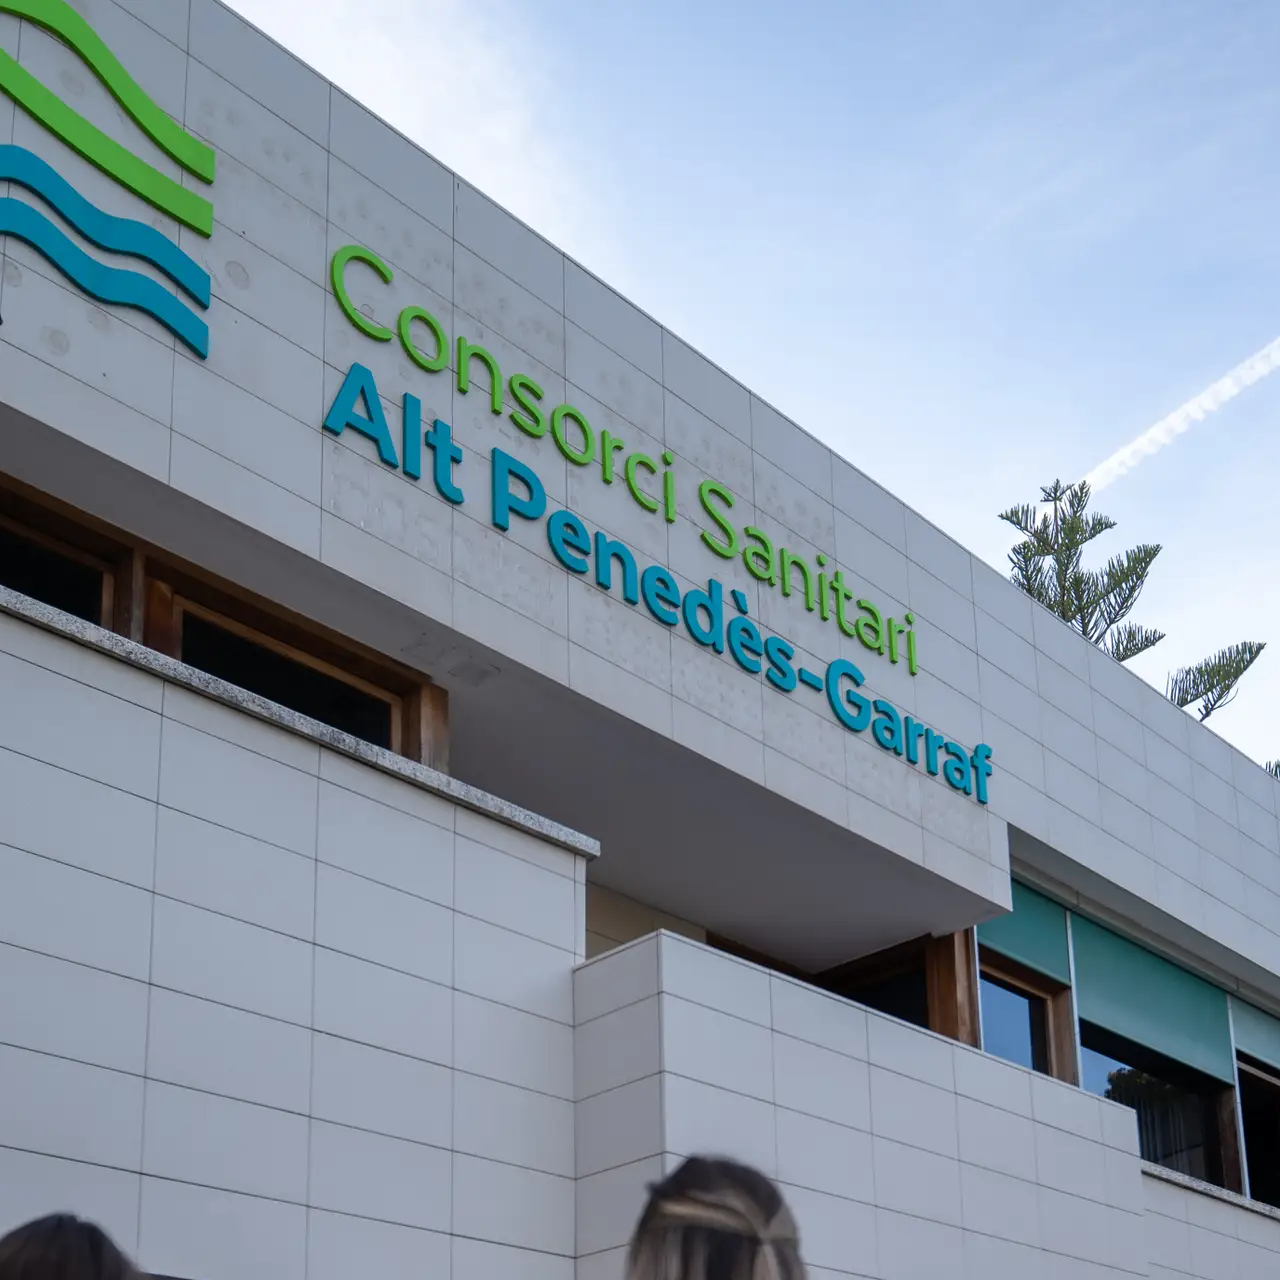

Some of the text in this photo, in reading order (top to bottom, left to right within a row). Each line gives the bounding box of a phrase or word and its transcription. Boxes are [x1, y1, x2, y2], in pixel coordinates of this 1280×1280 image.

[322, 362, 993, 805] Alt Penedès-Garraf
[330, 245, 918, 676] Consorci Sanitari
